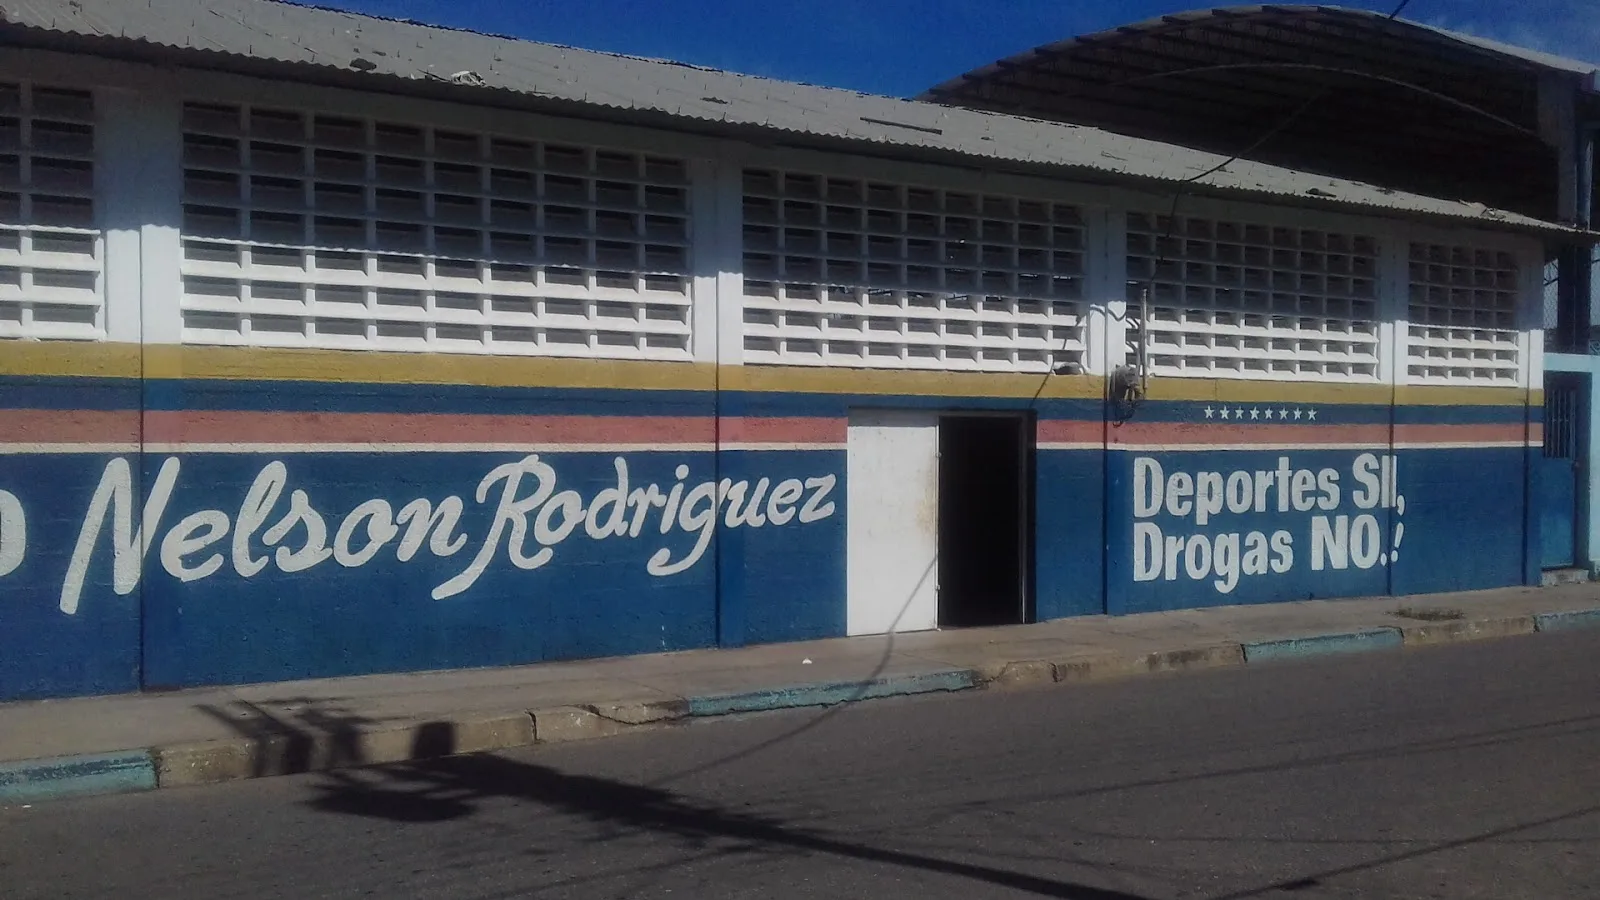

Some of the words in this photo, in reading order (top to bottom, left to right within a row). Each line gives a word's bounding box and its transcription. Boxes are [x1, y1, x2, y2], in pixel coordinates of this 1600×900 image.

[1133, 456, 1340, 525] Deportes
[60, 456, 468, 615] Nelson
[432, 453, 837, 600] Rodriguez
[1133, 521, 1293, 594] Drogas
